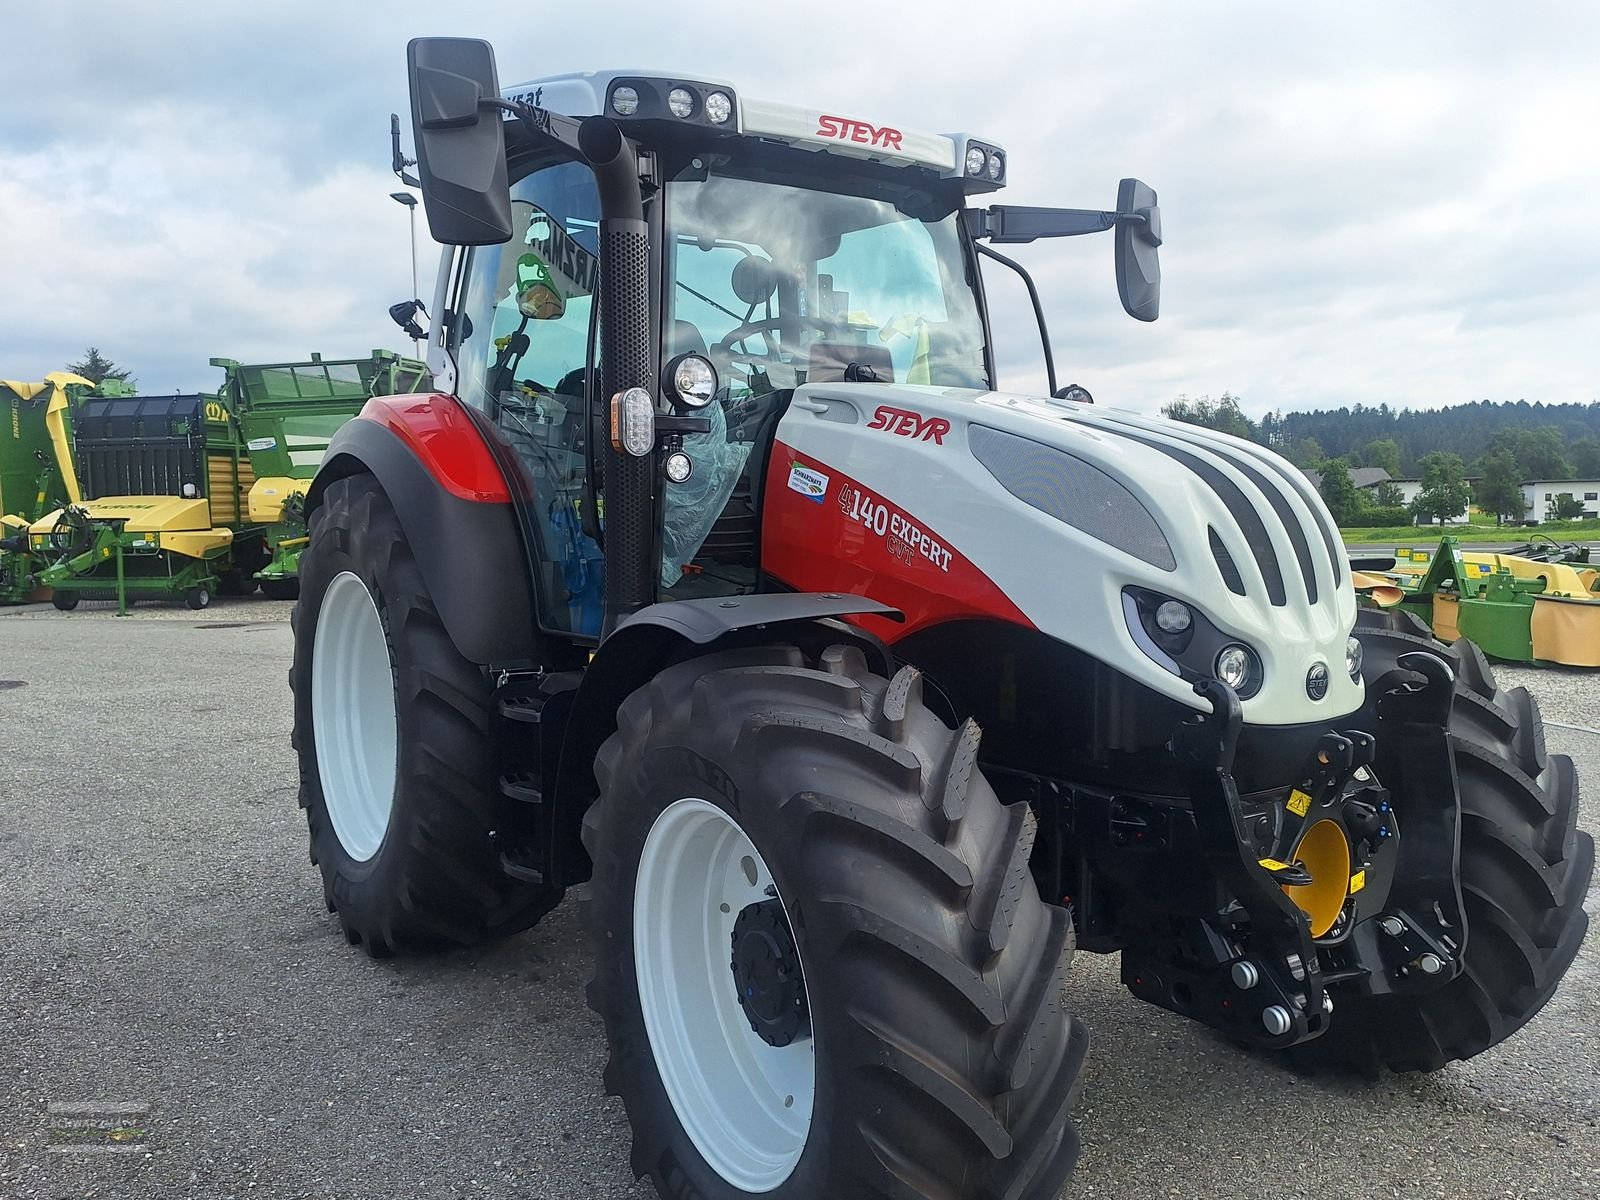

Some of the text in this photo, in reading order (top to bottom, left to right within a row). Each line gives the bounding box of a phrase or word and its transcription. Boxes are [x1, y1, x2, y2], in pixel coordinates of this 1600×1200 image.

[816, 115, 903, 150] STEYR
[867, 405, 951, 446] STEYR
[838, 483, 953, 573] 4140 EXPERT
[886, 535, 915, 568] CVT
